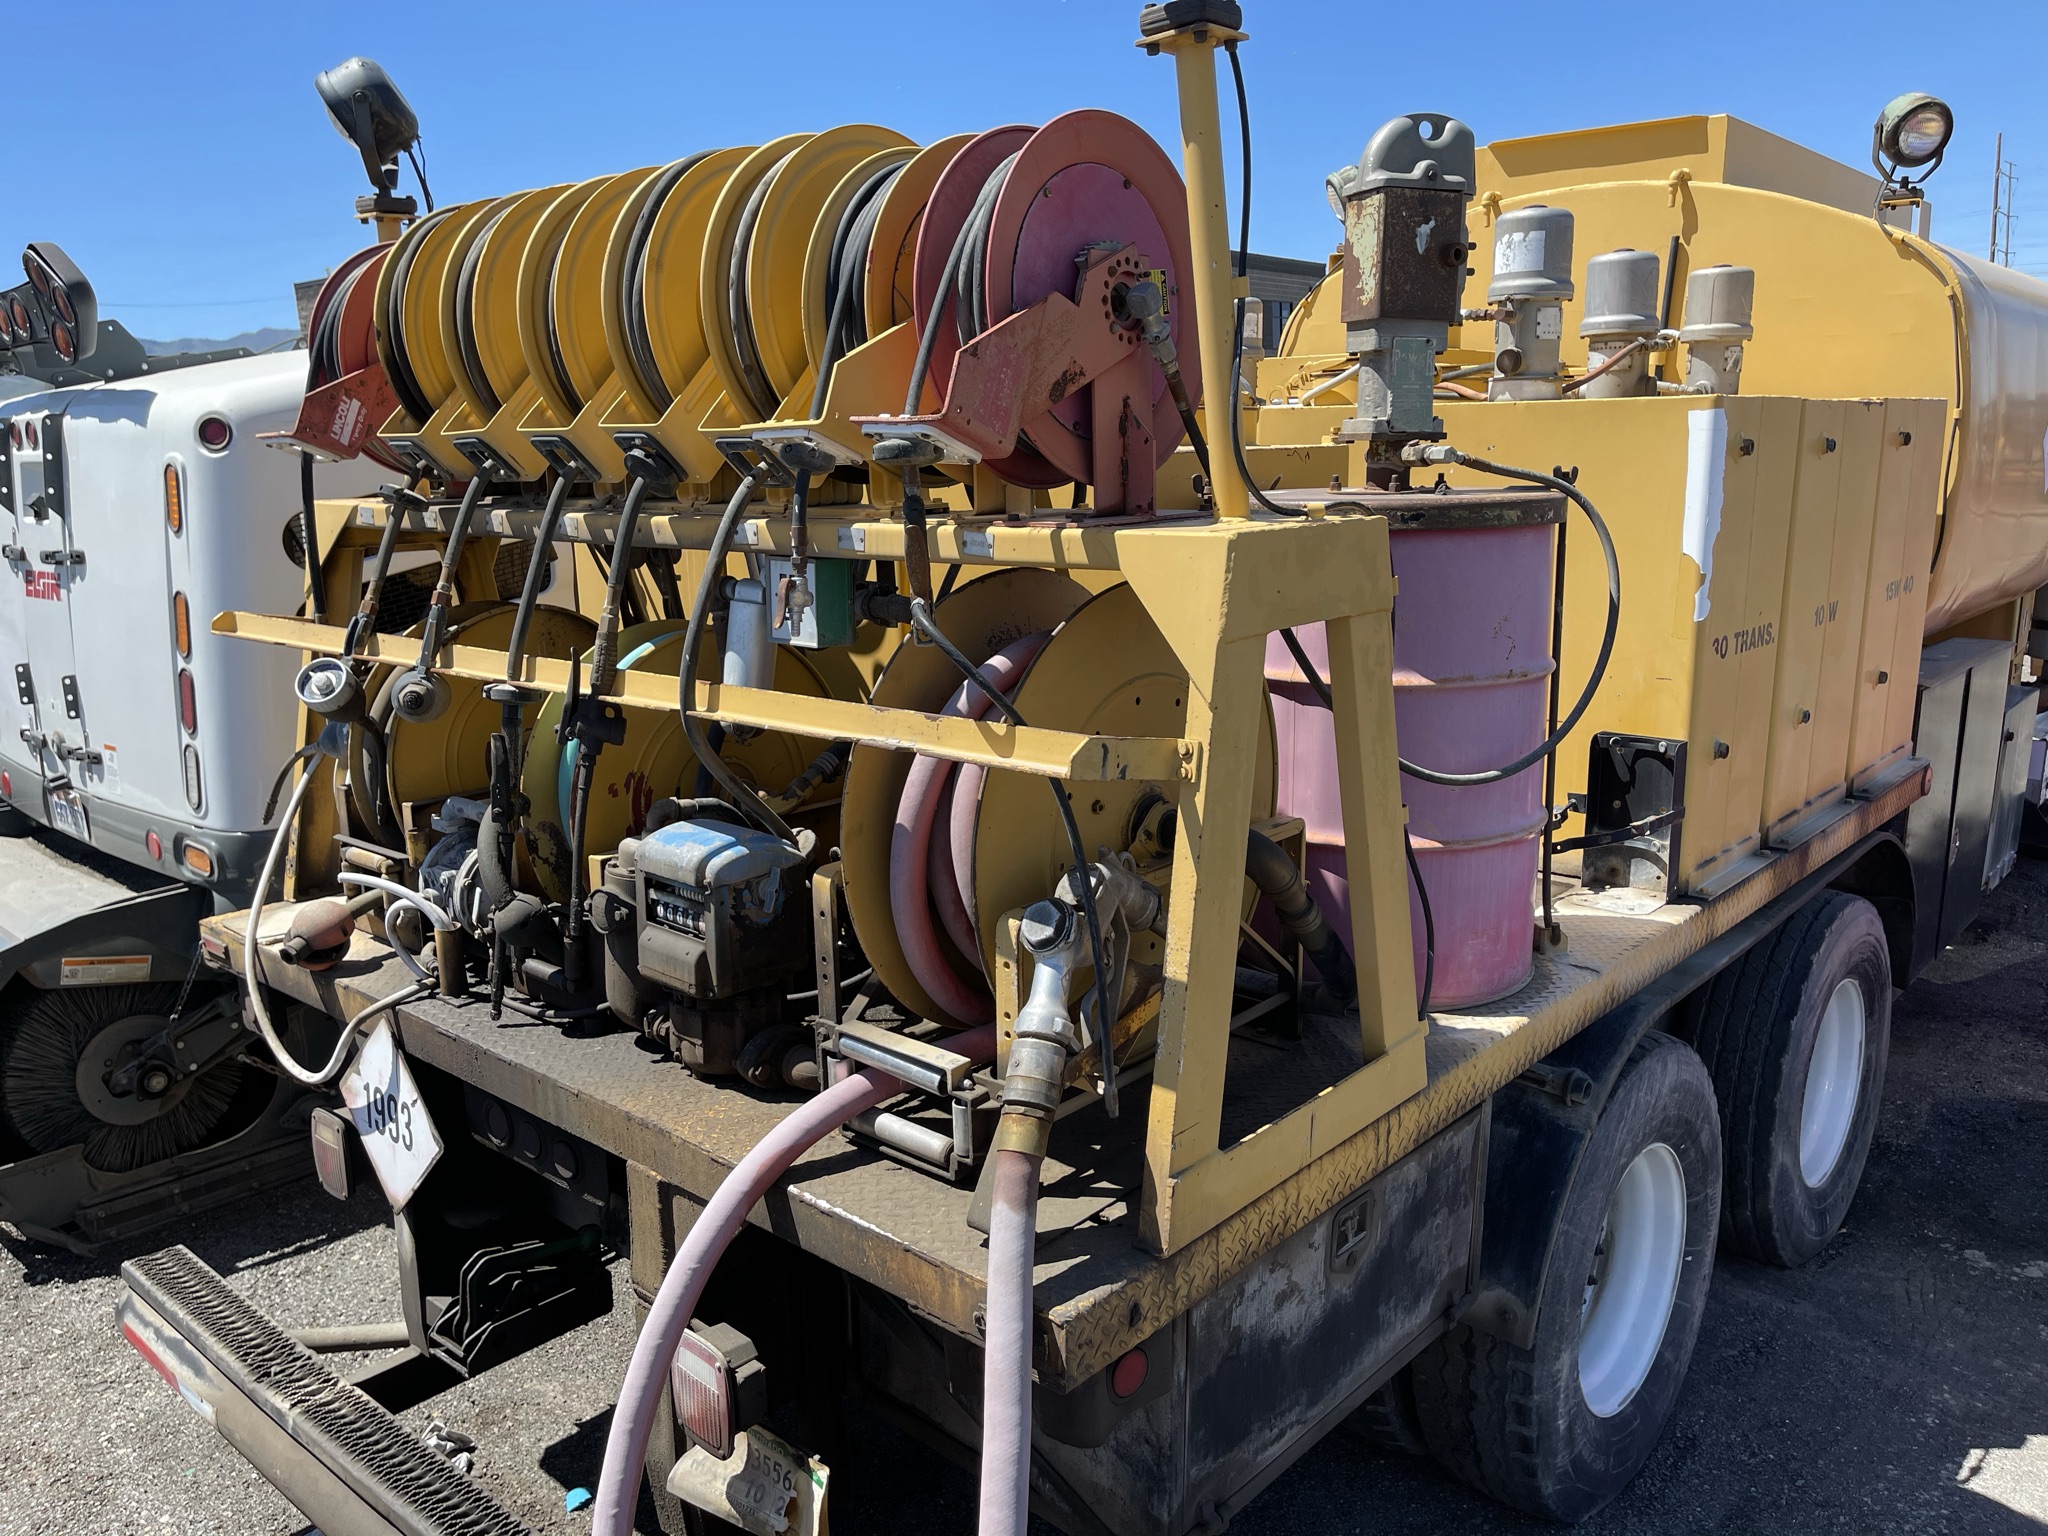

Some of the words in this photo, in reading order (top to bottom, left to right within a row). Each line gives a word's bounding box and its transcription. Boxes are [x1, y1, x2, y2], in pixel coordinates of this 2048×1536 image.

[26, 569, 61, 602] ELGIN
[1885, 578, 1902, 602] 15W
[1902, 575, 1914, 595] 40
[1814, 604, 1825, 627] 10
[1828, 600, 1839, 622] W
[1734, 622, 1775, 655] TRANS.
[363, 1081, 413, 1152] 1993
[747, 1428, 785, 1457] OLORADO
[745, 1479, 766, 1504] 10
